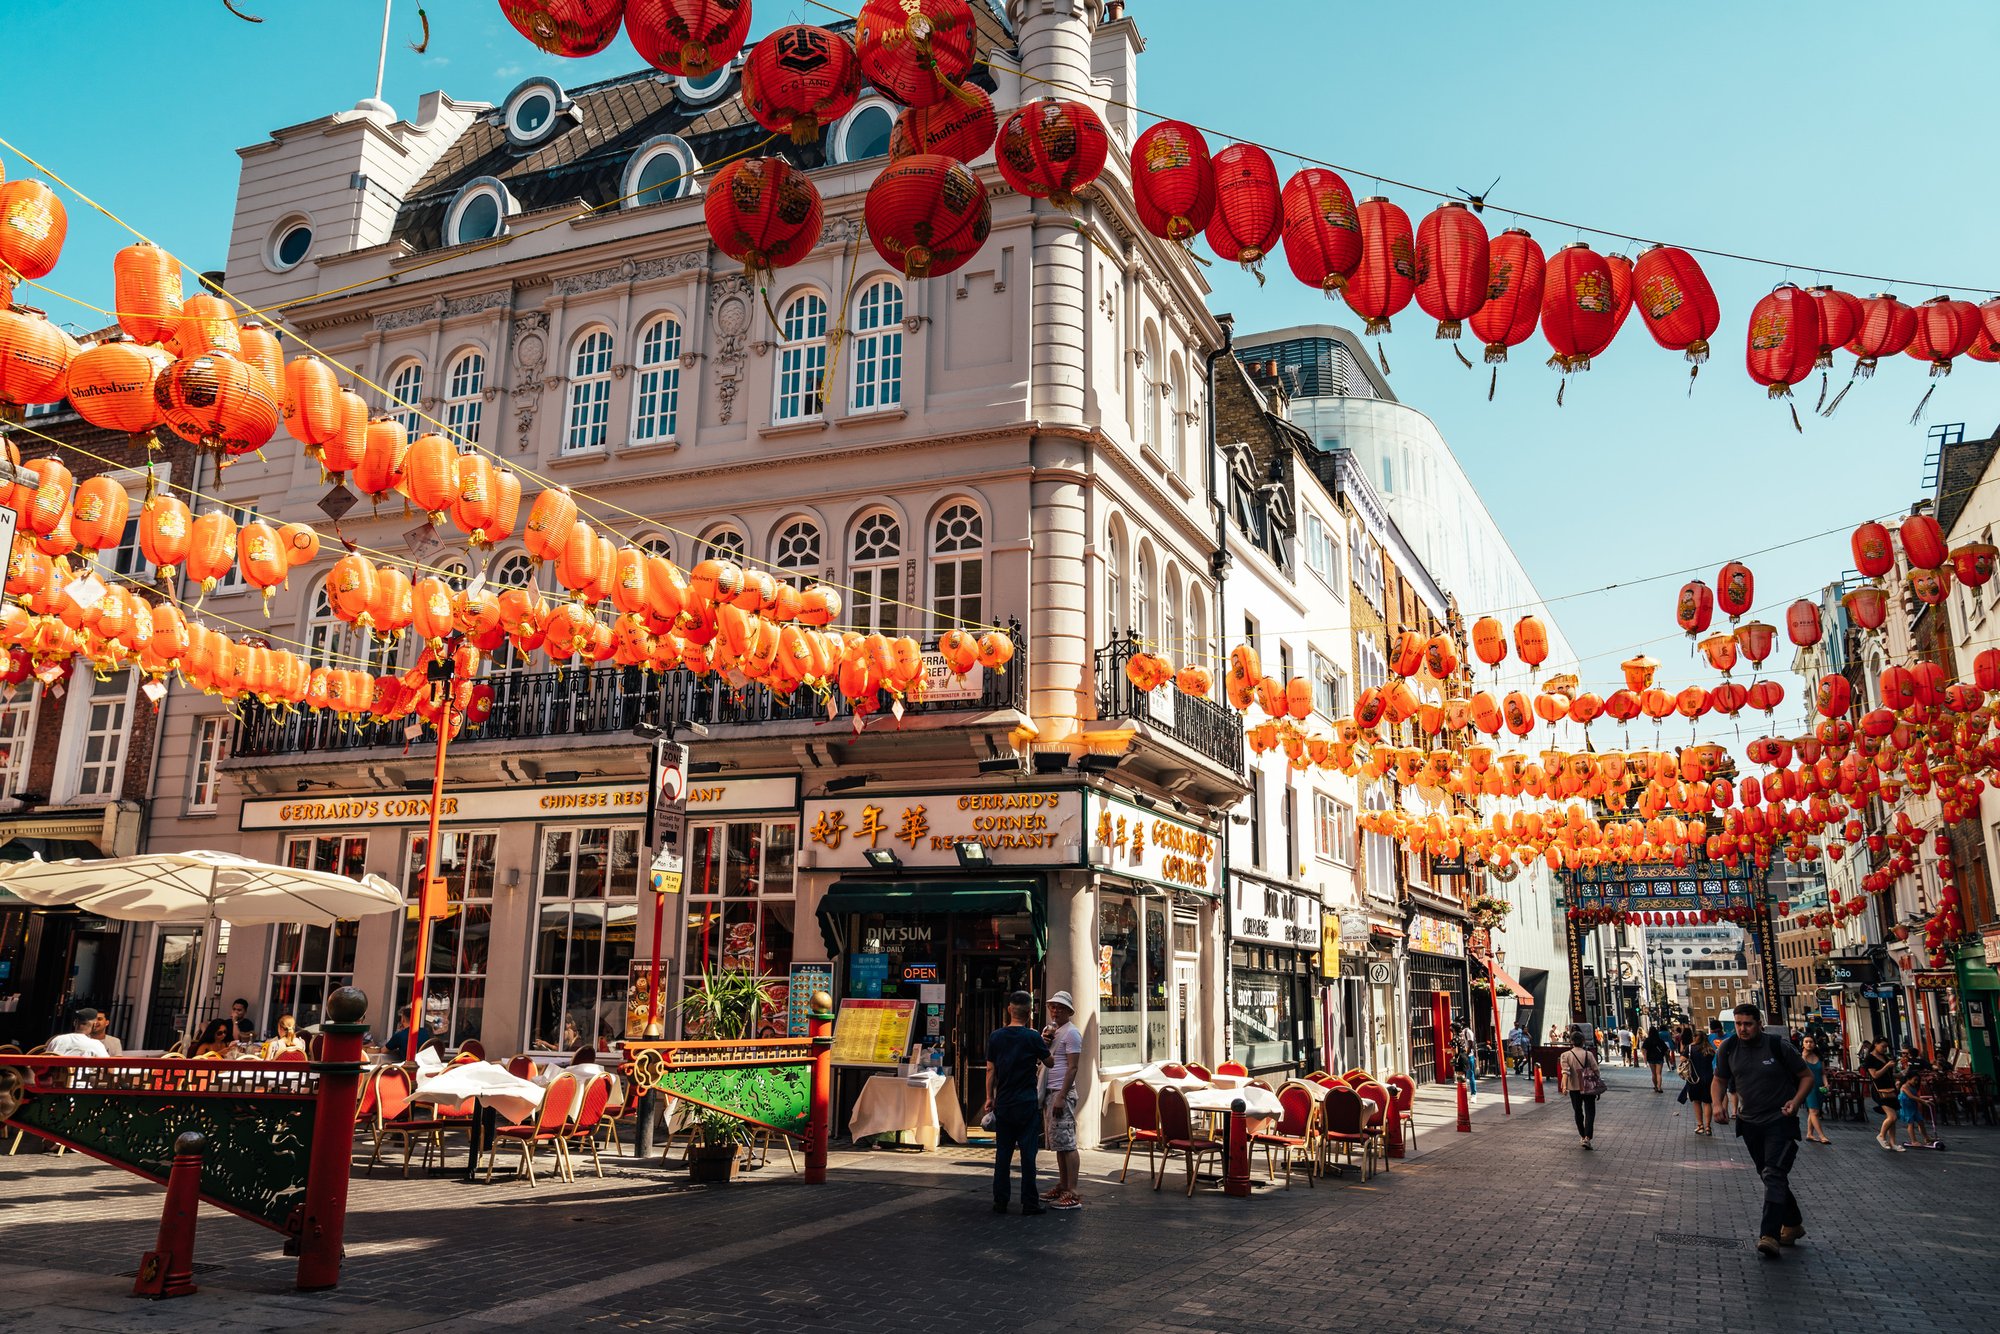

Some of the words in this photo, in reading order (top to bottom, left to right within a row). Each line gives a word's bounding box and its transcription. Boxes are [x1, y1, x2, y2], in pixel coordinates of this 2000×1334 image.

[802, 80, 830, 88] LAND
[927, 667, 948, 677] REET
[663, 751, 683, 765] ZONE
[539, 793, 607, 810] CHINESE
[612, 786, 726, 806] RESANT
[956, 793, 1059, 811] GERRARD'S
[280, 800, 379, 821] GERRARD'S
[659, 813, 674, 823] Except
[659, 821, 673, 831] loading
[810, 803, 930, 849] 好年華
[972, 814, 1047, 832] CORNER
[1152, 819, 1214, 863] GERRARD'S
[1162, 854, 1207, 889] CORNER
[867, 927, 896, 941] DIM
[899, 927, 931, 941] SUM
[904, 968, 936, 979] OPEN
[1237, 989, 1252, 1006] HOT
[1253, 990, 1277, 1006] BUFFET
[1115, 1024, 1139, 1035] RESTAURANT
